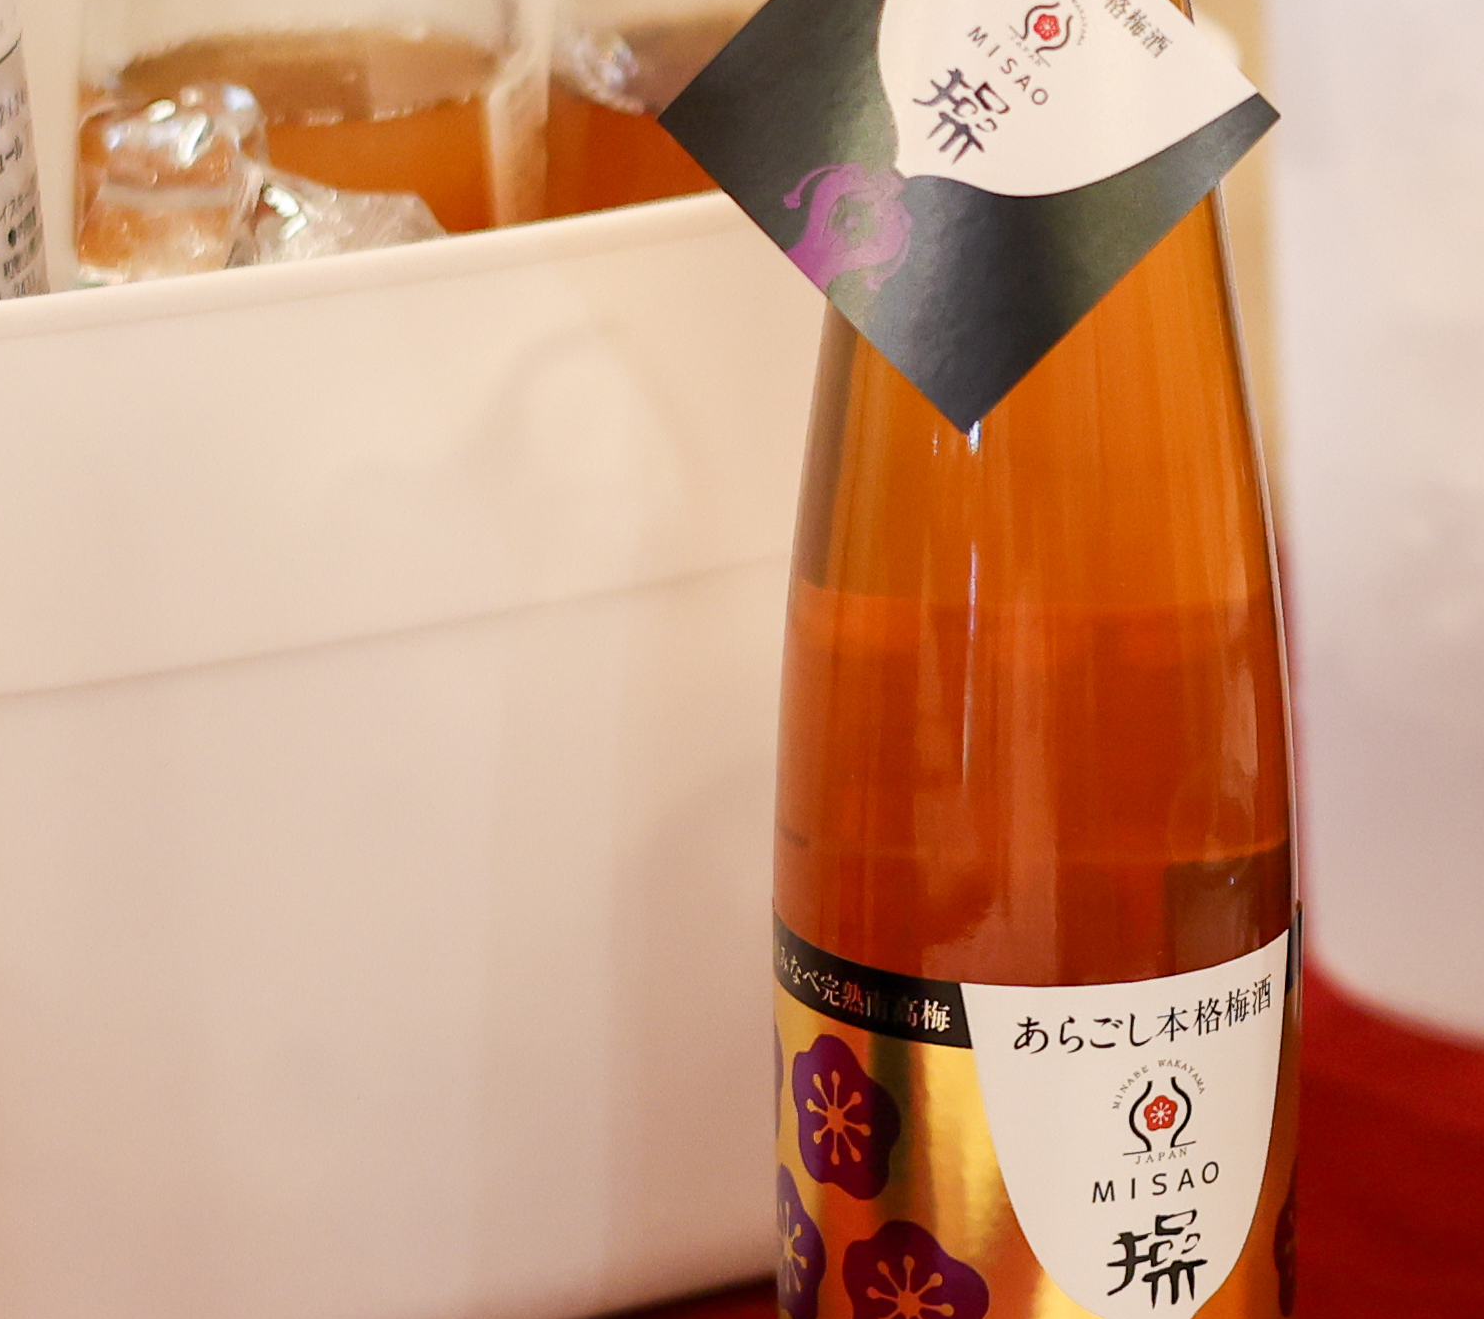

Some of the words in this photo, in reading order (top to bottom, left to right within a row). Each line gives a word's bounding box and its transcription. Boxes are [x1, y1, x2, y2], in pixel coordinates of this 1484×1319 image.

[968, 25, 1050, 107] MISAO
[1013, 973, 1273, 1056] あらごし本格梅酒
[1157, 1059, 1206, 1095] WAKAYAMA
[1135, 1146, 1188, 1165] JAPAN
[1092, 1161, 1221, 1204] MISAO
